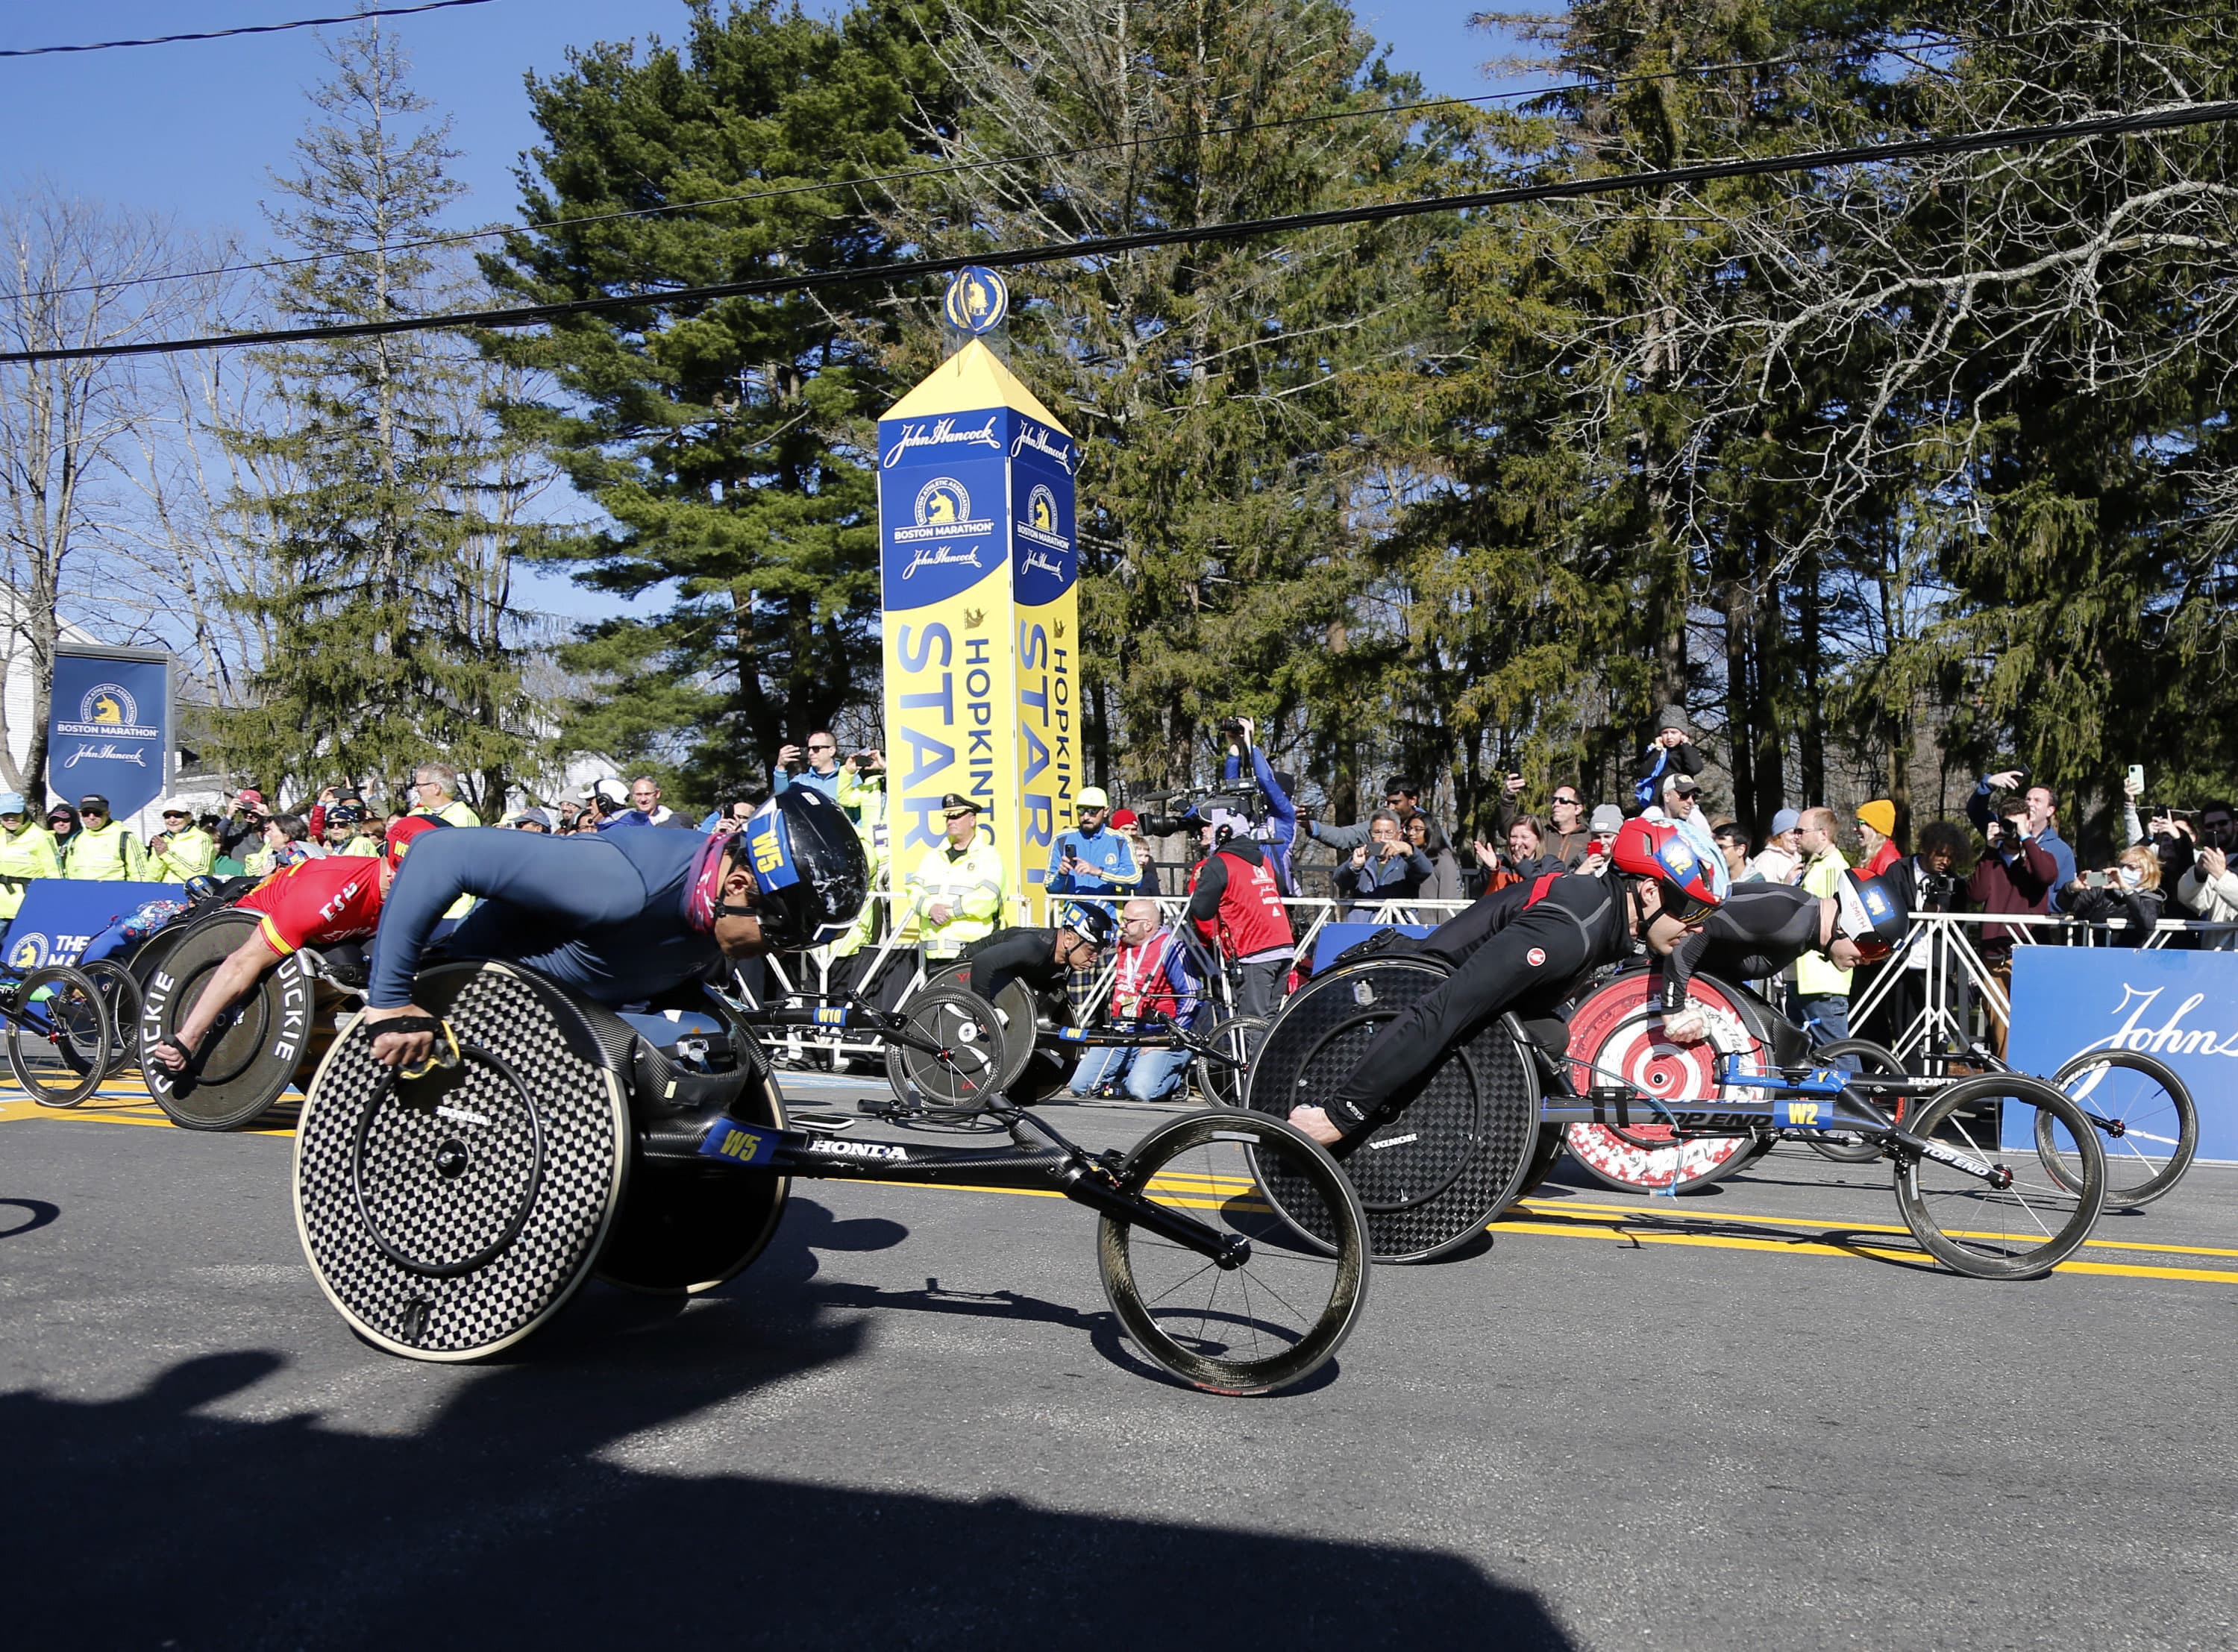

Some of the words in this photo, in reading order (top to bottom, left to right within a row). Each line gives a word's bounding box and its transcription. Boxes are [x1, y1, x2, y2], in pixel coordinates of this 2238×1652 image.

[883, 424, 930, 468] John
[929, 416, 1001, 449] Hancock
[1011, 420, 1038, 457] John
[1034, 428, 1072, 475] Hancock
[894, 528, 933, 540] BOSTON
[1018, 524, 1039, 539] BOSTON
[902, 550, 934, 580] John
[933, 545, 982, 568] Hancock
[83, 696, 91, 720] BOSTON
[91, 685, 116, 697] ATHLETIC
[57, 723, 98, 733] BOSTON
[1053, 648, 1073, 829] HOPKINT
[64, 743, 98, 768] John
[98, 744, 146, 767] Hancock
[897, 622, 956, 884] STAR
[1020, 618, 1053, 883] STAR
[752, 829, 784, 873] W5
[1665, 844, 1693, 876] W2
[1850, 900, 1866, 929] SMITH
[56, 935, 91, 952] THE
[273, 956, 304, 1062] UICKIE
[818, 1008, 841, 1023] W10
[436, 1105, 491, 1126] HONDA
[1650, 1111, 1706, 1125] TOP
[1708, 1113, 1773, 1126] END
[1788, 1102, 1819, 1125] W2
[720, 1128, 762, 1161] W5
[809, 1139, 909, 1161] HONDA
[1369, 1134, 1417, 1149] HONDA
[1922, 1144, 1954, 1163] TOP
[1951, 1158, 1990, 1177] END
